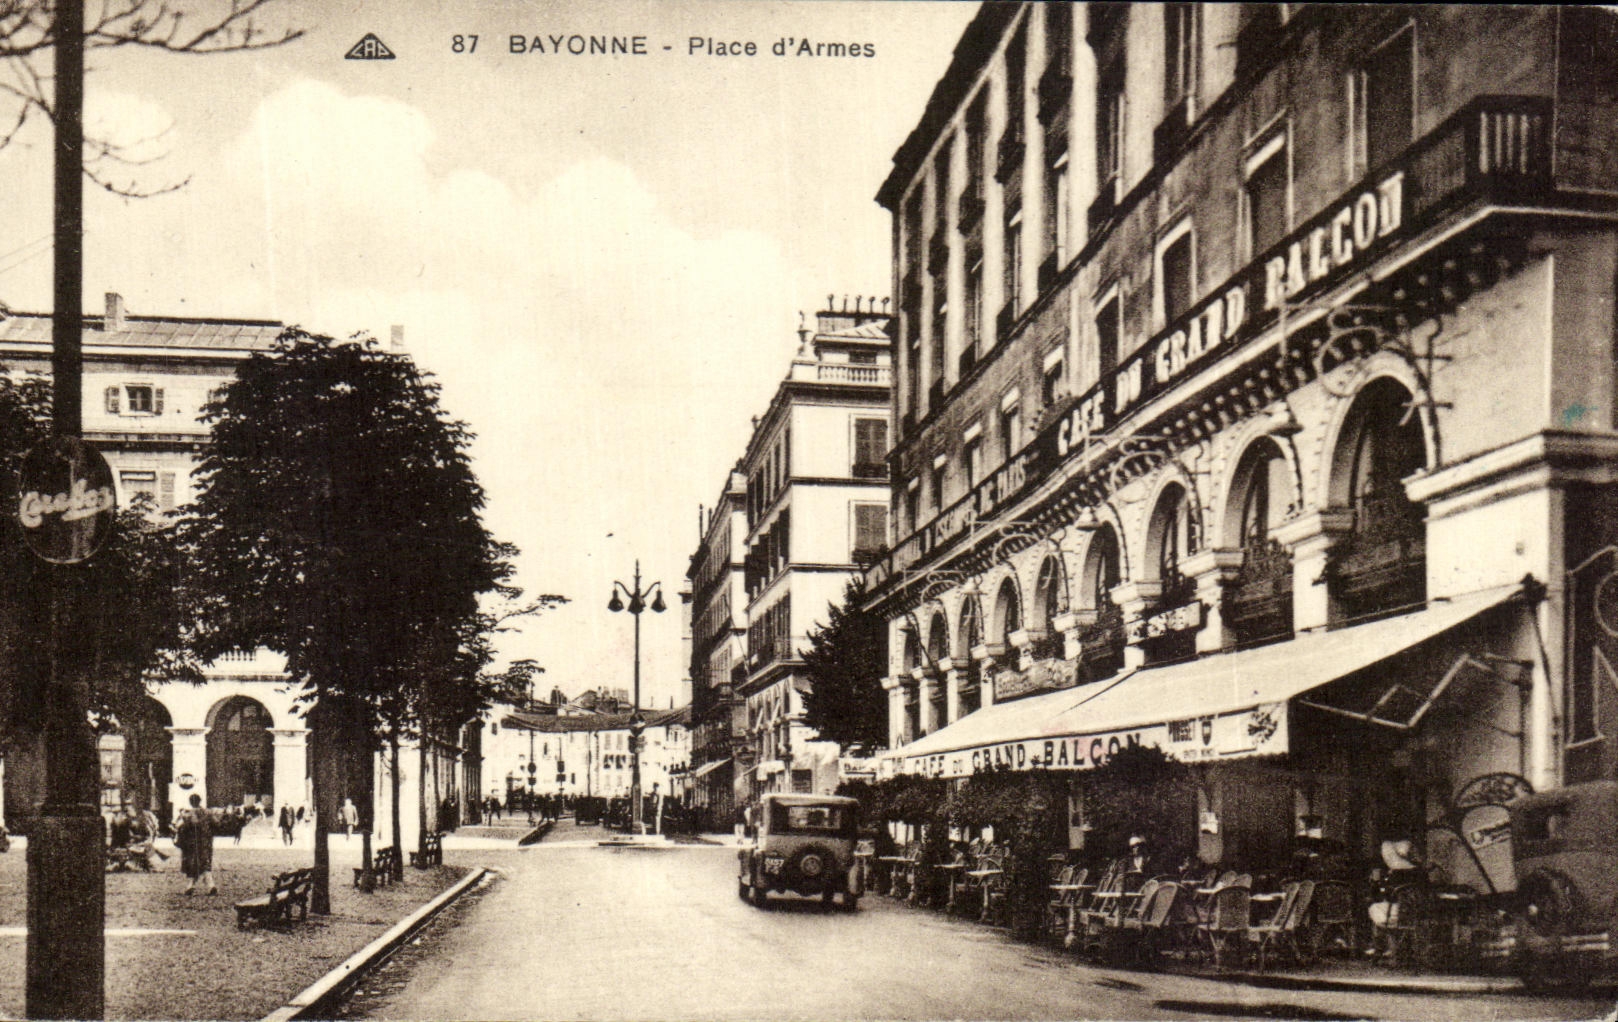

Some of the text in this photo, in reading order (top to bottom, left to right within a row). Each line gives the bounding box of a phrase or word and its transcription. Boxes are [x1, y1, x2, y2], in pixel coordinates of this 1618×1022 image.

[1114, 357, 1142, 415] DU
[1156, 286, 1244, 383] GRAND
[1264, 171, 1404, 311] BALCON
[971, 743, 1026, 774] GRAND
